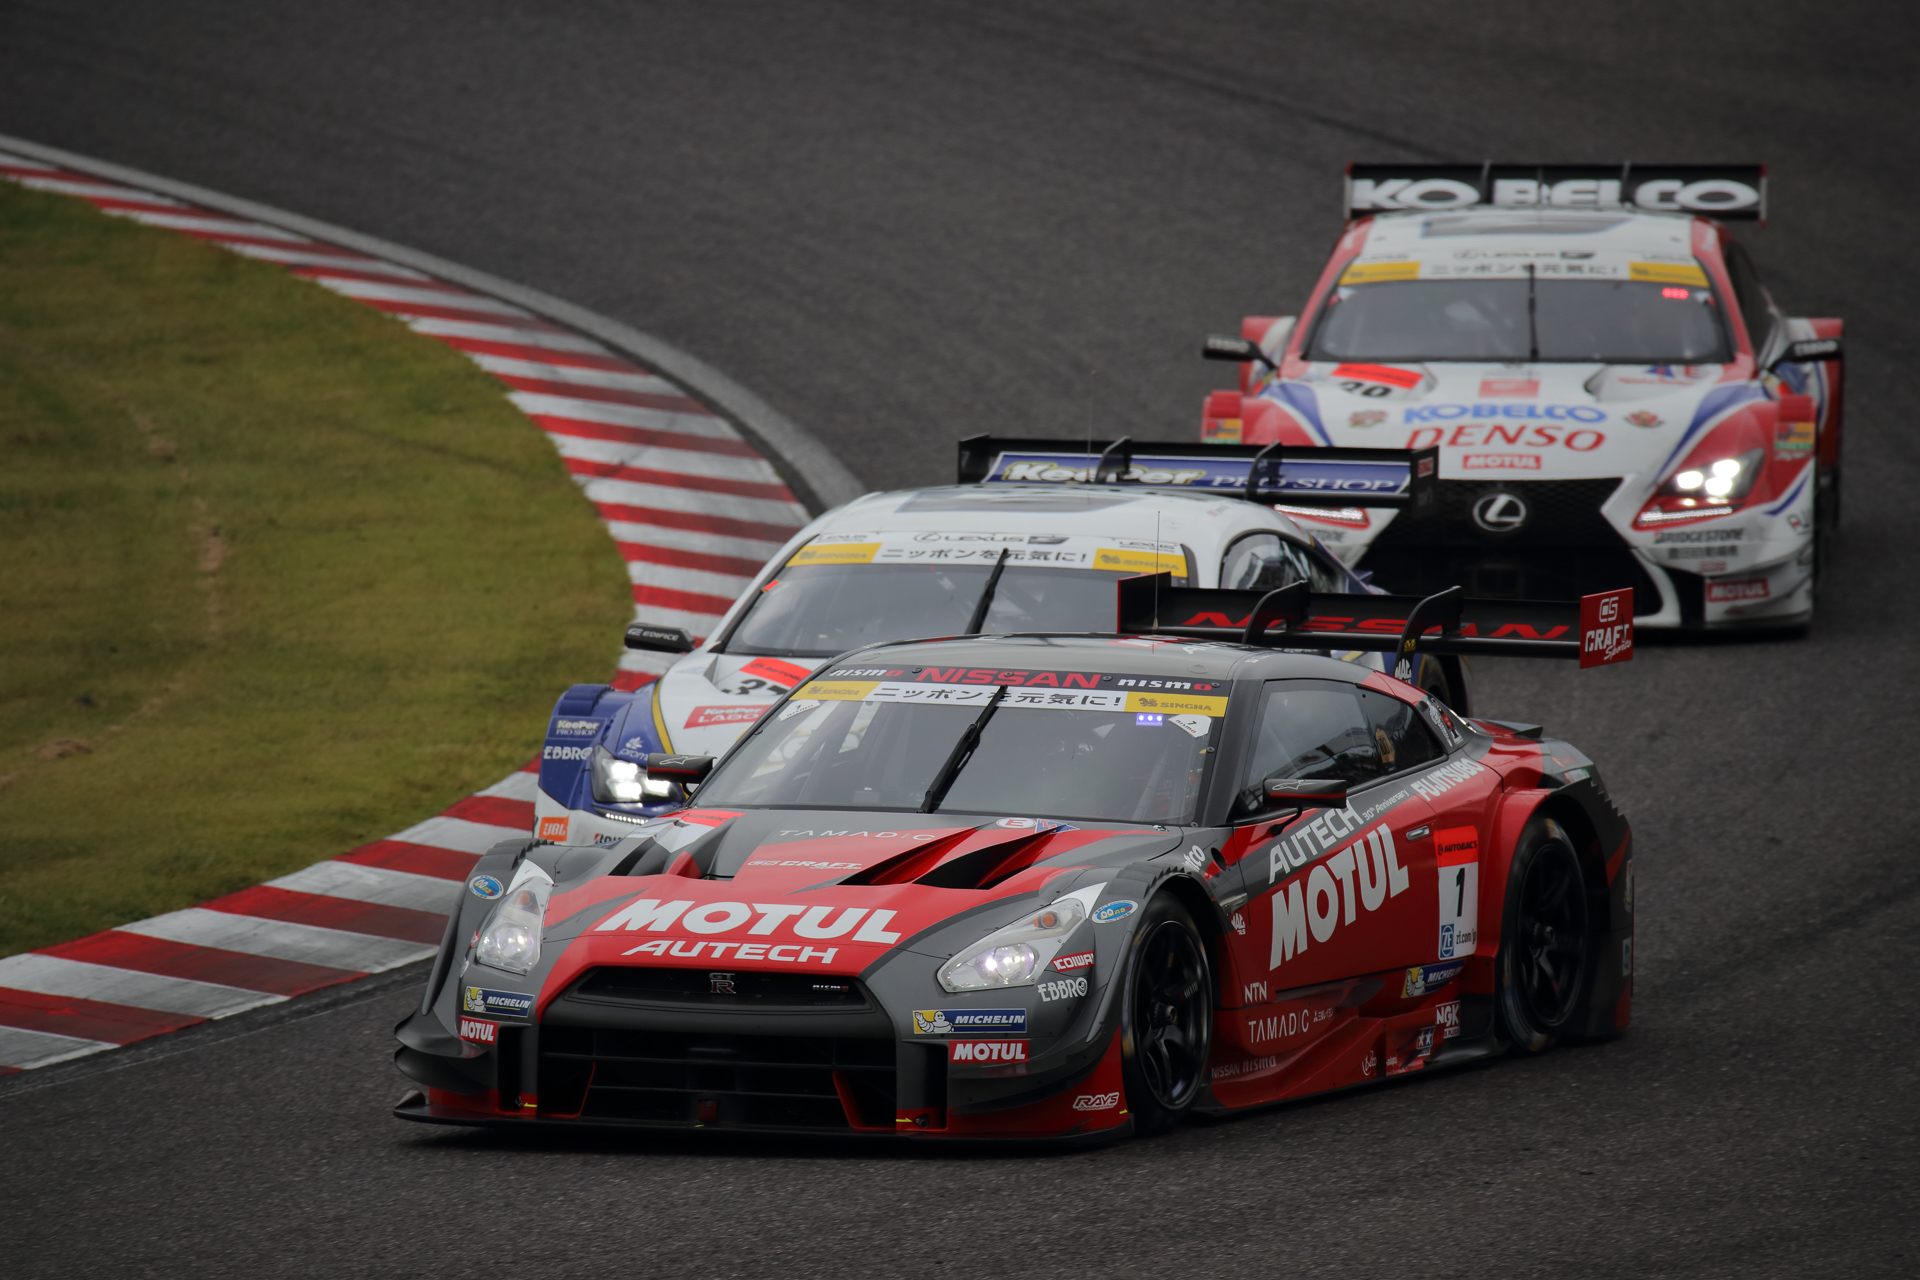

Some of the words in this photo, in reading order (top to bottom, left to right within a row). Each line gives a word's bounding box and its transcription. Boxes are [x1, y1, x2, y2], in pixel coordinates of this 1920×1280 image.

[1352, 178, 1760, 210] KOBELCO
[1404, 403, 1607, 424] KOBELCO
[1405, 424, 1606, 452] DENSO
[1465, 455, 1538, 469] MOTUL
[1293, 478, 1394, 491] SHOP
[945, 535, 1024, 543] LEXUS
[1654, 527, 1744, 544] BRIDGESTONE
[1711, 581, 1766, 598] MOTUL
[642, 630, 680, 642] EDIFICE
[1585, 623, 1630, 653] CRAFT
[829, 667, 904, 680] nismo
[916, 668, 1102, 690] NISSAN
[1117, 678, 1214, 691] nismo
[820, 687, 860, 697] SINGHA
[703, 706, 764, 716] KeePer
[1159, 701, 1213, 712] SINGHA
[556, 719, 600, 730] KeePer
[698, 711, 760, 724] LABO
[1410, 757, 1486, 802] FUJITSUBO
[543, 822, 566, 836] JBL
[780, 829, 936, 842] TAMADIC
[1269, 798, 1365, 885] AUTECH
[1375, 788, 1410, 814] Anniversary
[1443, 840, 1478, 854] AUTOBACS
[779, 860, 863, 869] CRAFT
[1269, 822, 1410, 972] MOTUL
[1455, 867, 1466, 917] 1
[593, 897, 902, 945] MOTUL
[620, 938, 840, 964] AUTECH
[708, 972, 736, 980] GT
[710, 979, 737, 994] R
[811, 983, 850, 992] nismo
[1037, 976, 1088, 1002] EBBRO
[1244, 980, 1268, 1004] NTN
[486, 994, 532, 1009] MICHELIN
[954, 1014, 1025, 1025] MICHELIN
[1436, 1003, 1460, 1027] NGK
[460, 1019, 495, 1042] MOTUL
[1248, 1008, 1310, 1045] TAMADIC
[952, 1042, 1026, 1061] MOTUL
[1211, 1062, 1240, 1079] NISSAN
[1072, 1091, 1119, 1109] RAYS
